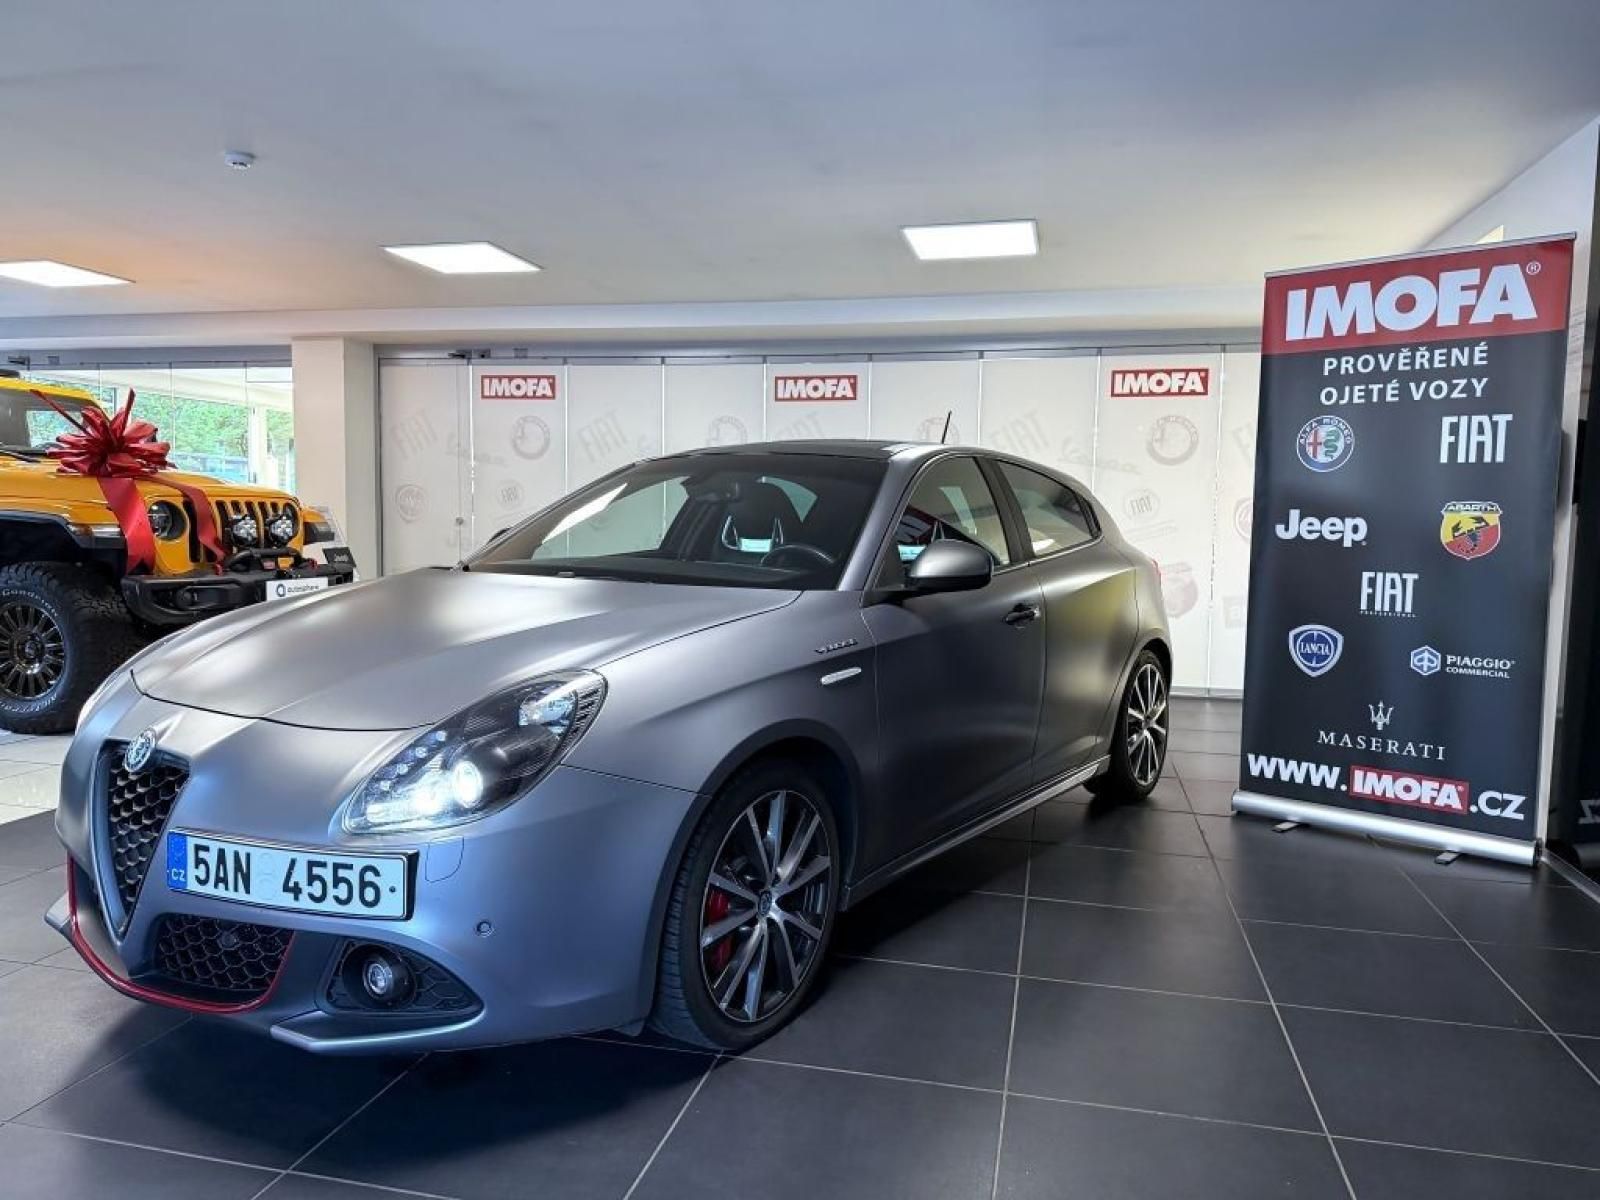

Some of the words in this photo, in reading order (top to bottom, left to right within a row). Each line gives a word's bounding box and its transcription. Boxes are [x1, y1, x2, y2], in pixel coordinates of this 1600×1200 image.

[1285, 263, 1538, 342] IMOFA
[1323, 341, 1489, 376] PROVĚŘENÉ
[483, 377, 554, 398] IMOFA
[777, 377, 855, 399] IMOFA
[1113, 370, 1206, 395] IMOFA
[1319, 380, 1400, 406] OJETÉ
[1409, 377, 1489, 402] VOZY
[1439, 413, 1514, 464] FIAT
[1275, 508, 1368, 548] Jeep
[1360, 571, 1420, 613] FIAT
[1446, 653, 1512, 671] PIAGGIO
[1446, 666, 1511, 679] COMMERCIAL
[1317, 730, 1447, 761] MASERATI
[171, 867, 187, 882] CZ
[192, 843, 252, 896] 5AN
[282, 857, 382, 909] 4556
